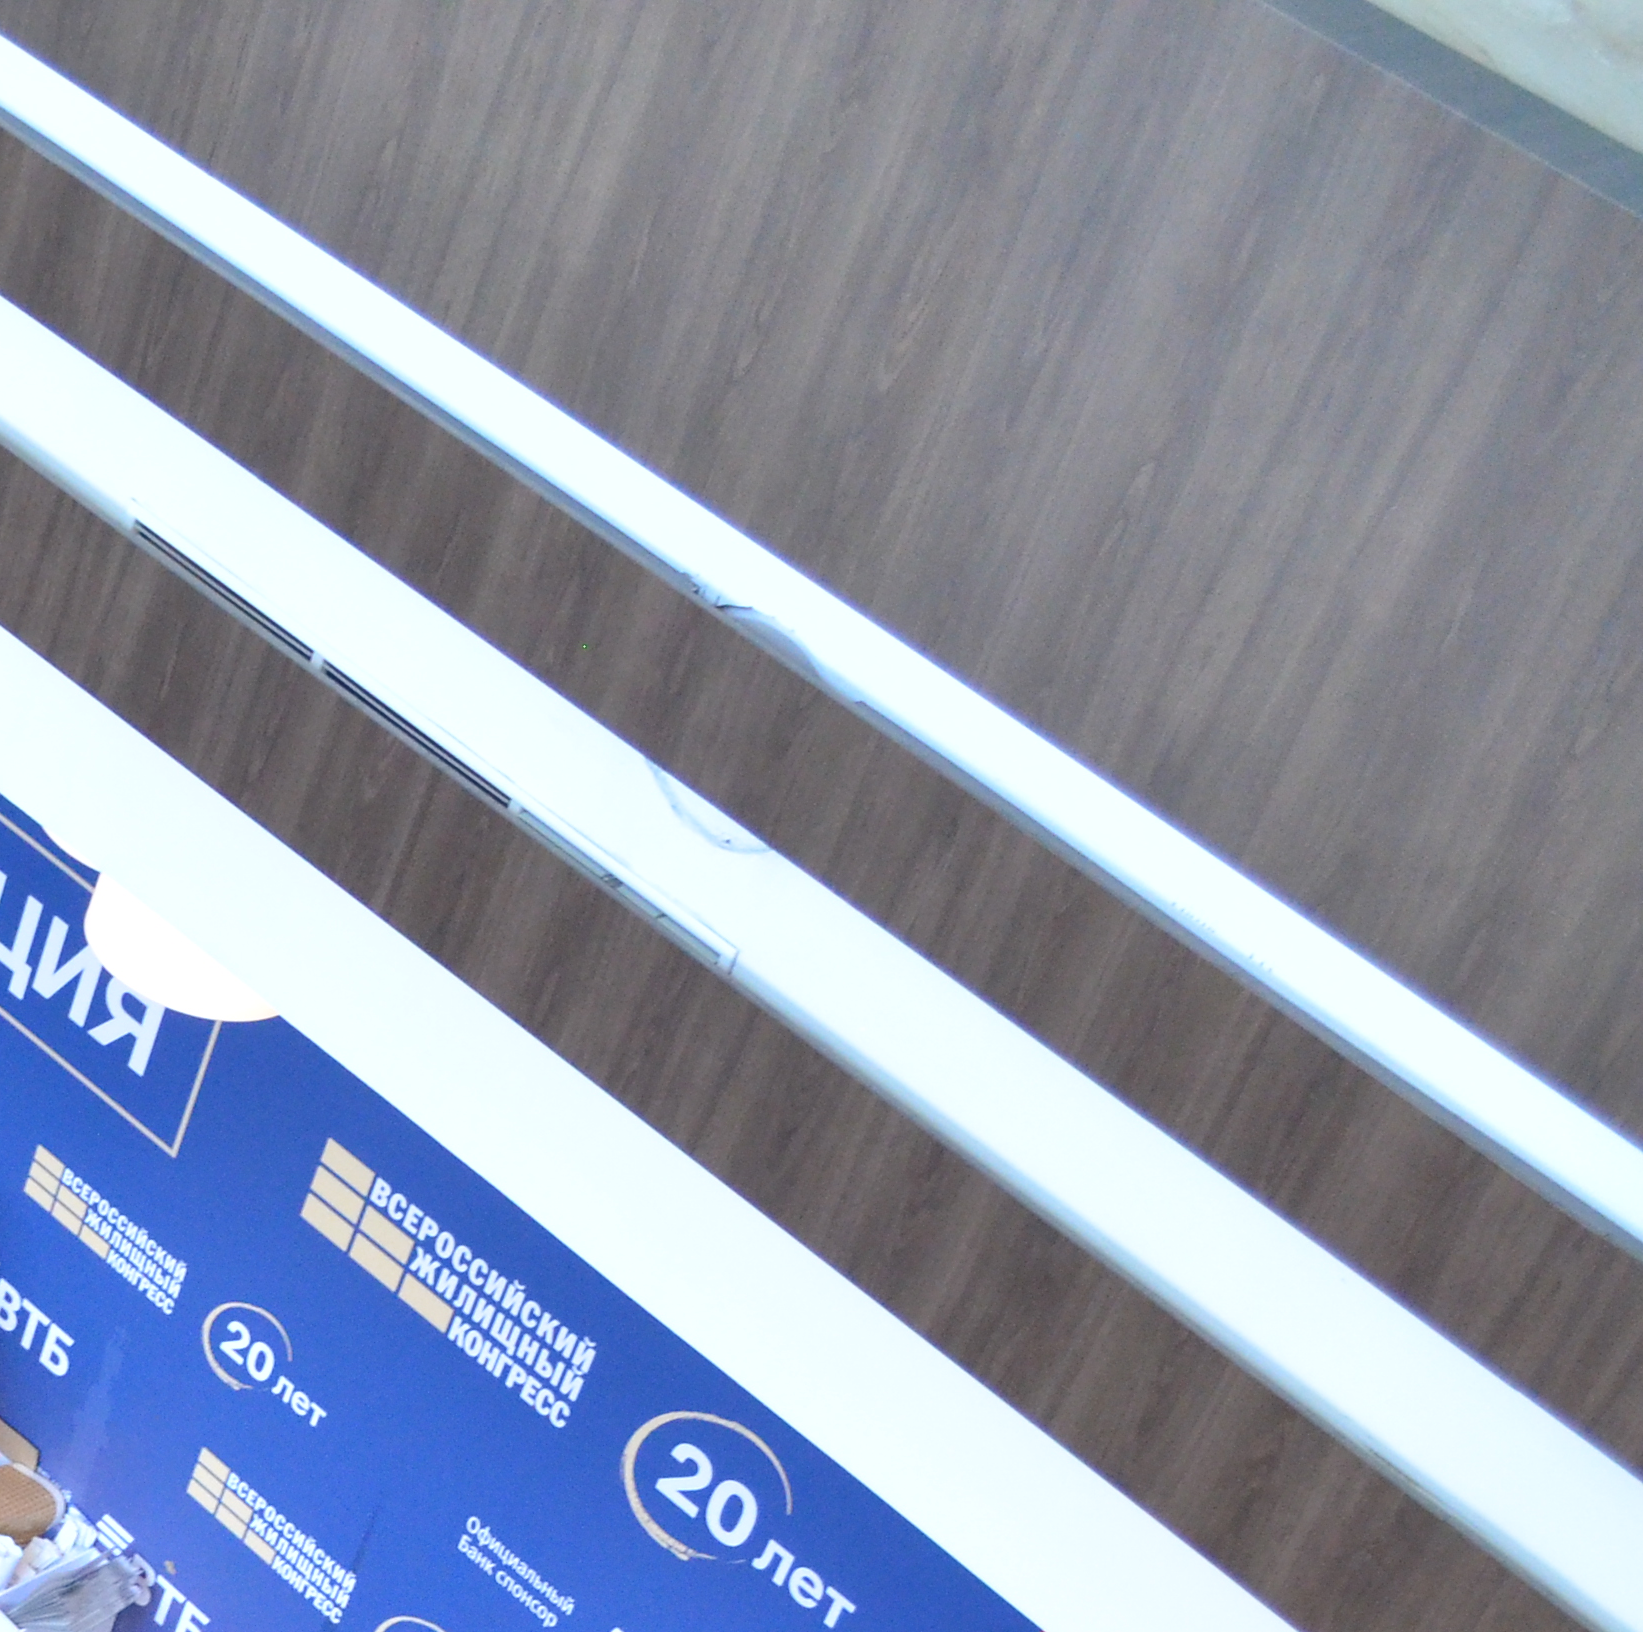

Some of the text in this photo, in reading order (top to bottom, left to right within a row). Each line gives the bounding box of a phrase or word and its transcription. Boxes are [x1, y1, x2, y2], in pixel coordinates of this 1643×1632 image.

[62, 1168, 188, 1283] ВСЕРОССИЙСКИЙ
[84, 1208, 181, 1299] ЖИЛИЩНЫЙ
[370, 1177, 597, 1375] ВСЕРОССИЙСКИЙ
[106, 1250, 175, 1316] КОНГРЕСС
[409, 1247, 584, 1402] ЖИЛИЩНЫЙ
[220, 1321, 327, 1427] 20 лет
[448, 1316, 571, 1428] КОНГРЕСС
[226, 1472, 356, 1593] ВСЕРОССИЙСКИЙ
[250, 1514, 350, 1610] ЖИЛИЩНЫЙ
[457, 1534, 558, 1628] Банк спонсор
[466, 1516, 575, 1616] Официальный
[655, 1443, 856, 1628] 20 лет
[271, 1555, 342, 1624] КОНГРЕСС
